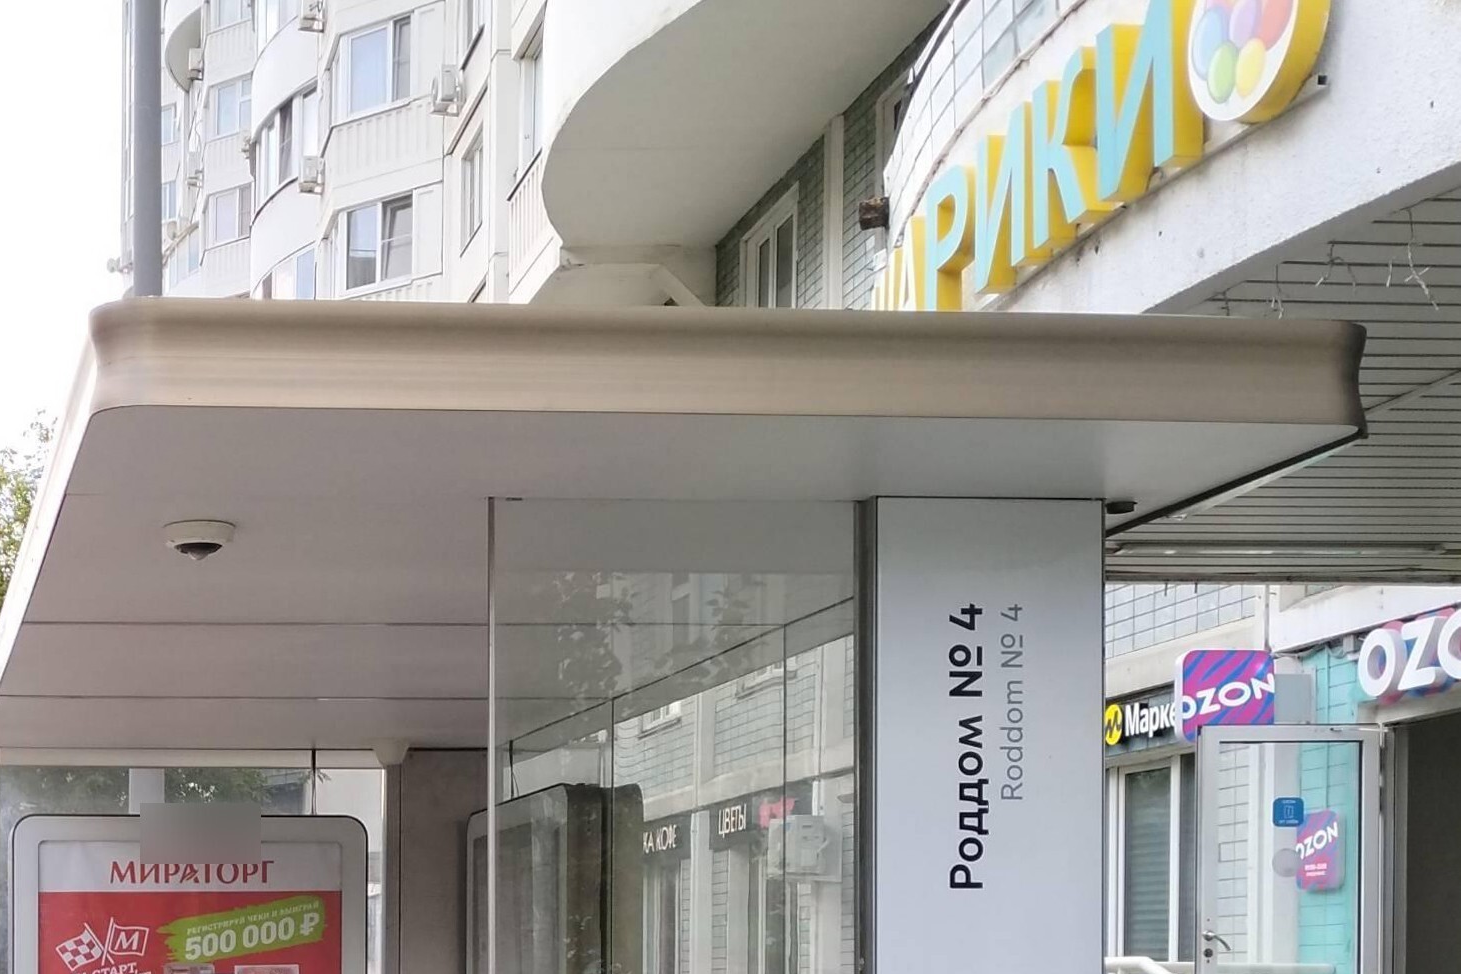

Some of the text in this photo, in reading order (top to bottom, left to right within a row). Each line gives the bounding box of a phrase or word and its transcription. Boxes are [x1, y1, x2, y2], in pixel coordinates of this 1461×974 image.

[948, 603, 983, 631] 4
[999, 604, 1024, 621] 4
[999, 680, 1024, 800] Roddom
[718, 803, 747, 838] ЦВЕТЫ
[949, 715, 989, 889] Роддом
[185, 929, 237, 961] 500
[242, 916, 296, 948] 000
